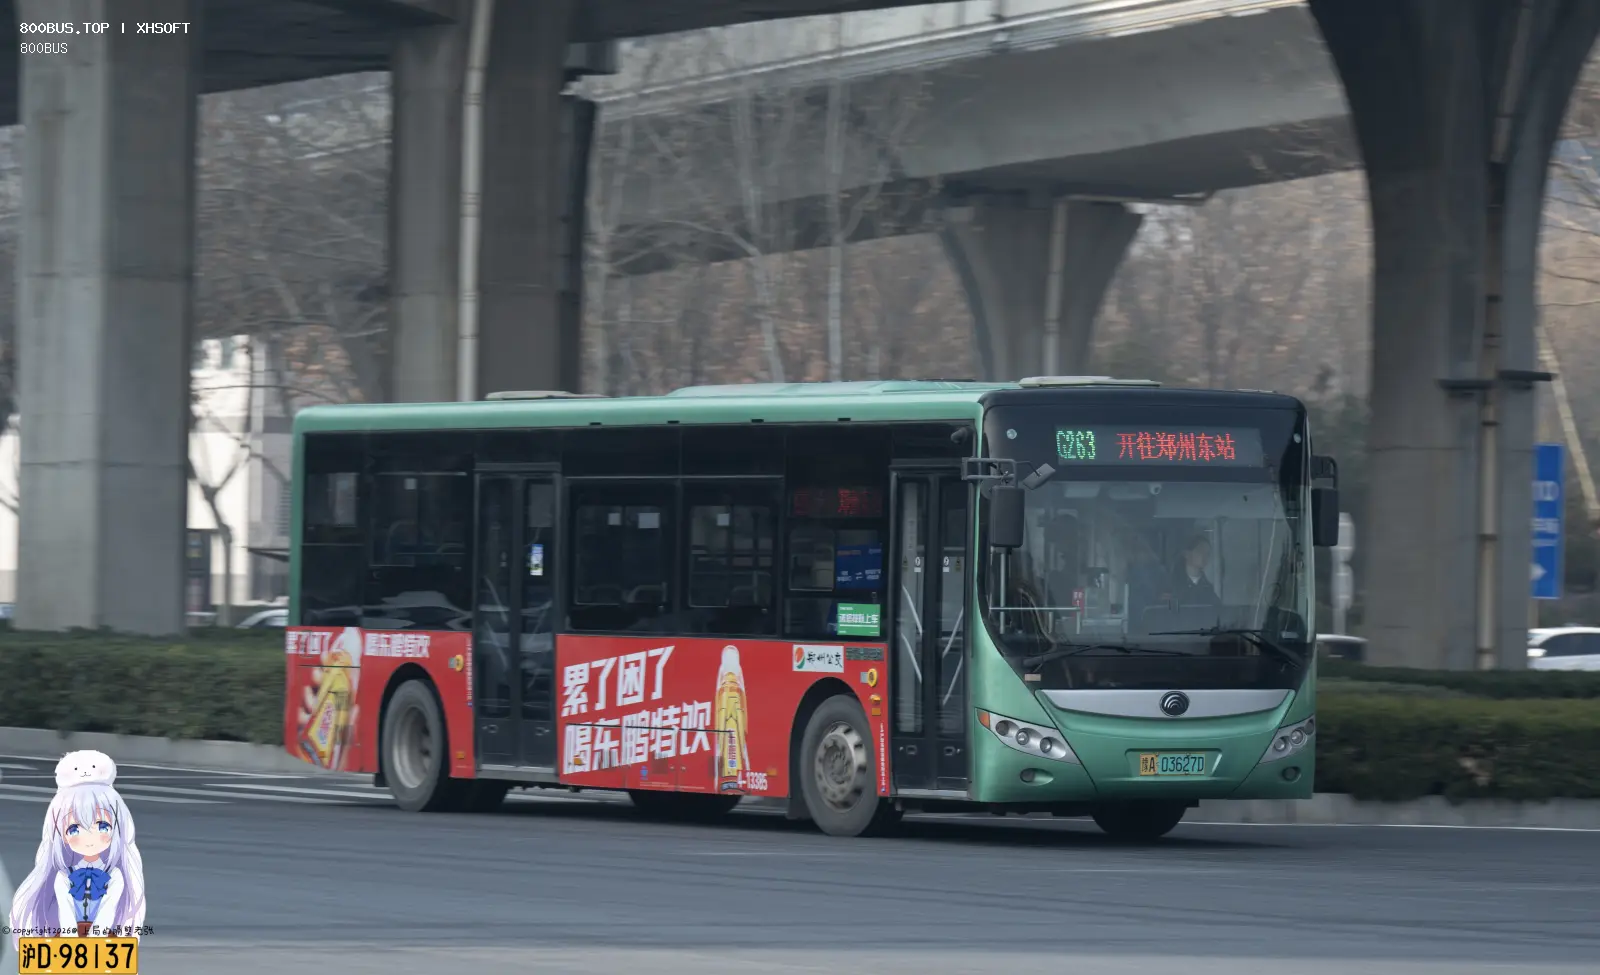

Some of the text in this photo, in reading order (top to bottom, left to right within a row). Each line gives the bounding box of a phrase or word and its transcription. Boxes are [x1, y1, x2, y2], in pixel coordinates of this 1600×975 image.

[1056, 430, 1236, 461] G263 开往郑州东站
[561, 645, 675, 717] 累了困了
[563, 700, 712, 775] 喝东鹏特饮
